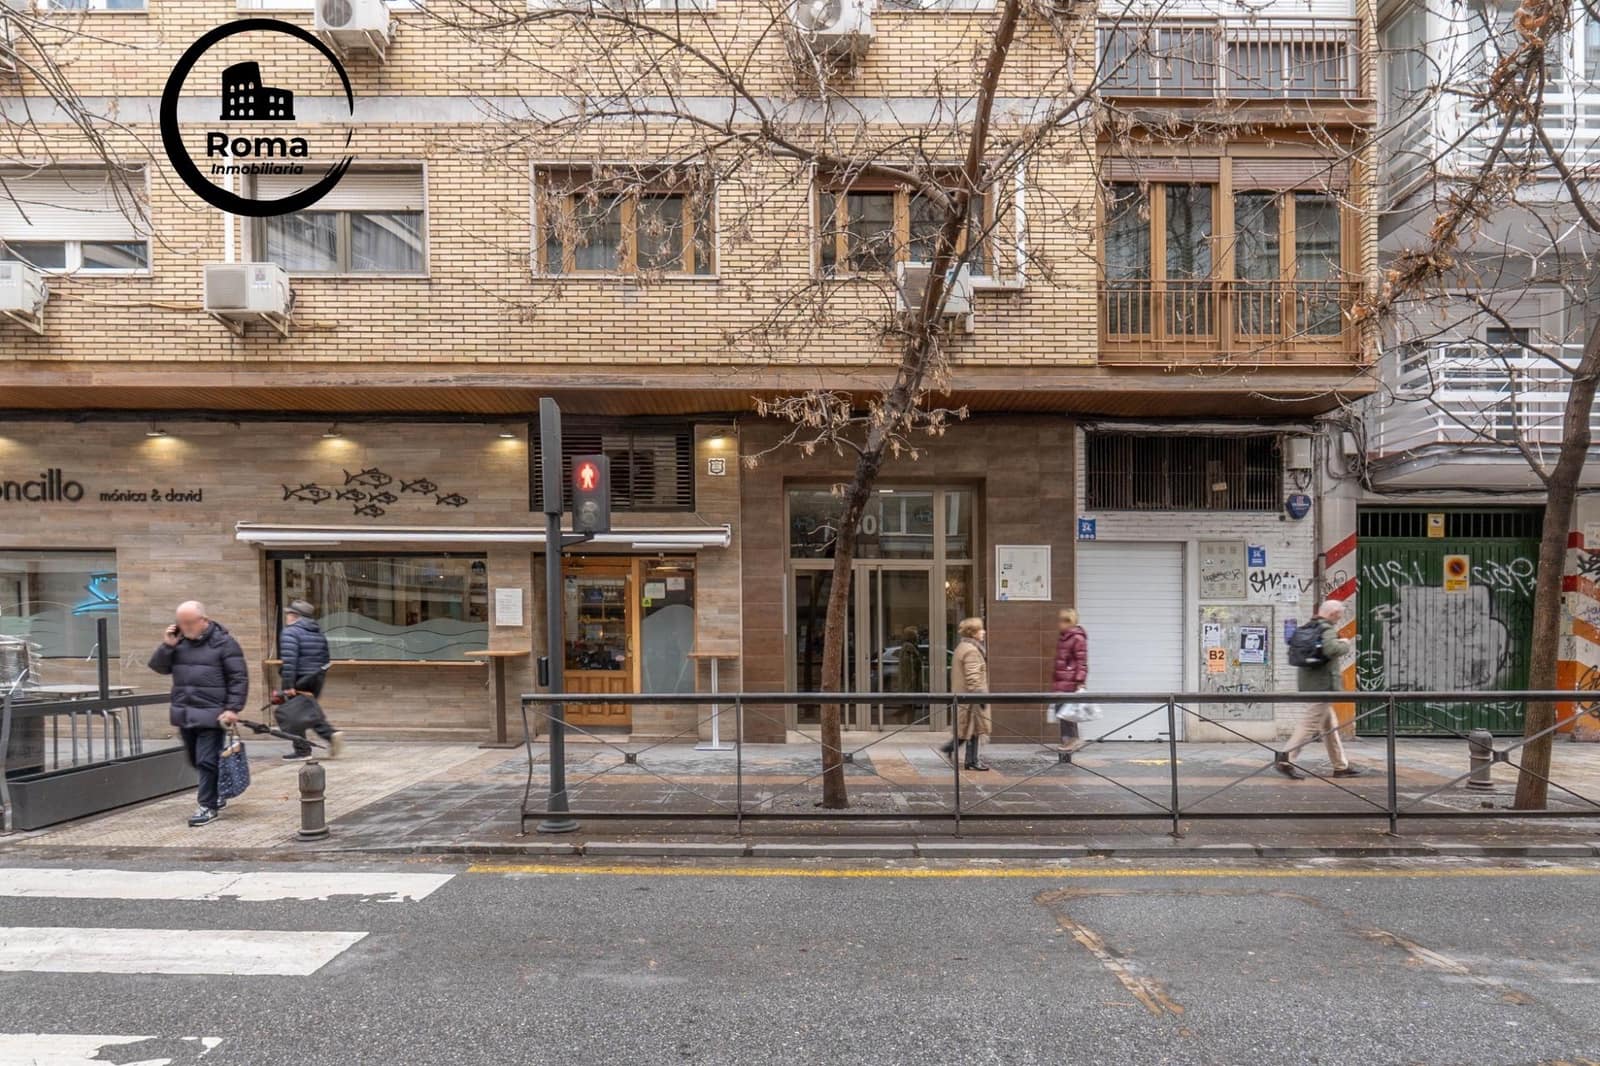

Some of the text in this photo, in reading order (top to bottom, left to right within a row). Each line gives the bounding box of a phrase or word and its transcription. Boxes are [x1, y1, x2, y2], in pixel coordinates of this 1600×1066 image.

[0, 468, 84, 501] ncillo
[100, 488, 202, 502] mónica & david
[1209, 650, 1225, 660] B2
